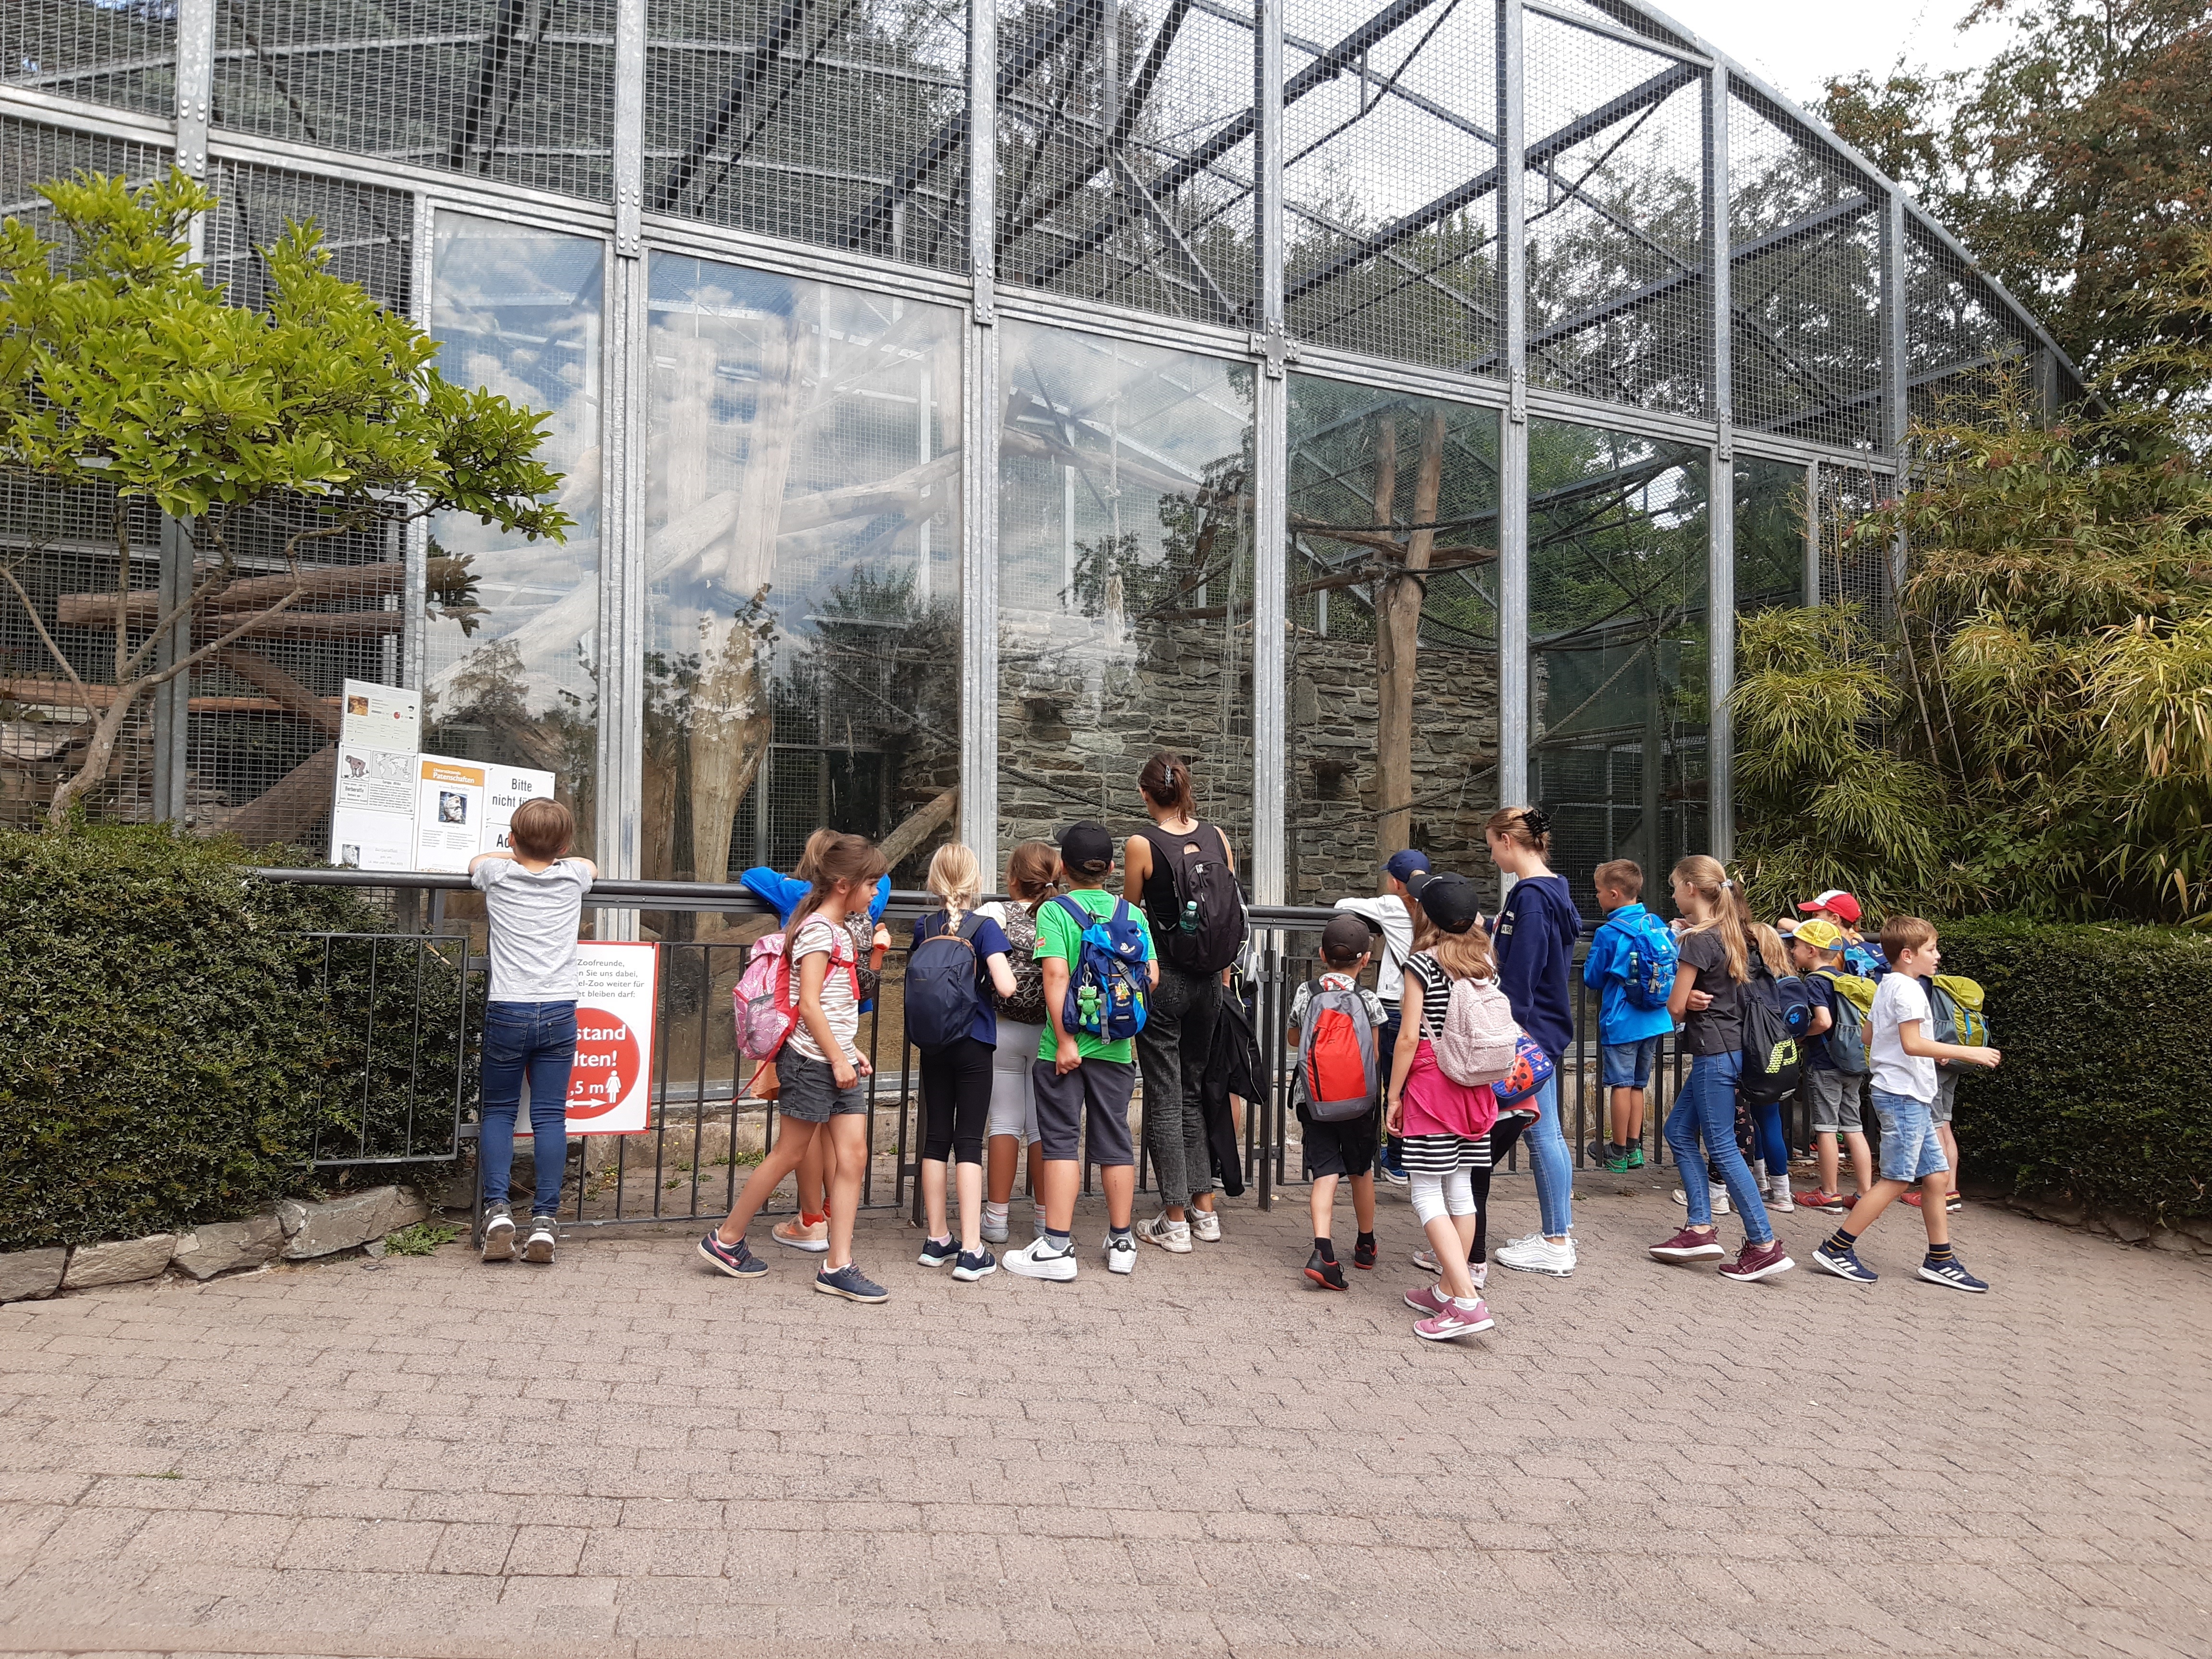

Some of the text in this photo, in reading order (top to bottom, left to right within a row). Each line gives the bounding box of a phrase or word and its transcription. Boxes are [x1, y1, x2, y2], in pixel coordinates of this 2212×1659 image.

[433, 772, 475, 783] Patenschaften
[511, 778, 532, 792] Bitte
[492, 793, 516, 807] nicht
[577, 959, 625, 967] Zoofreunde,
[573, 1050, 617, 1067] lten!
[589, 1084, 604, 1094] m
